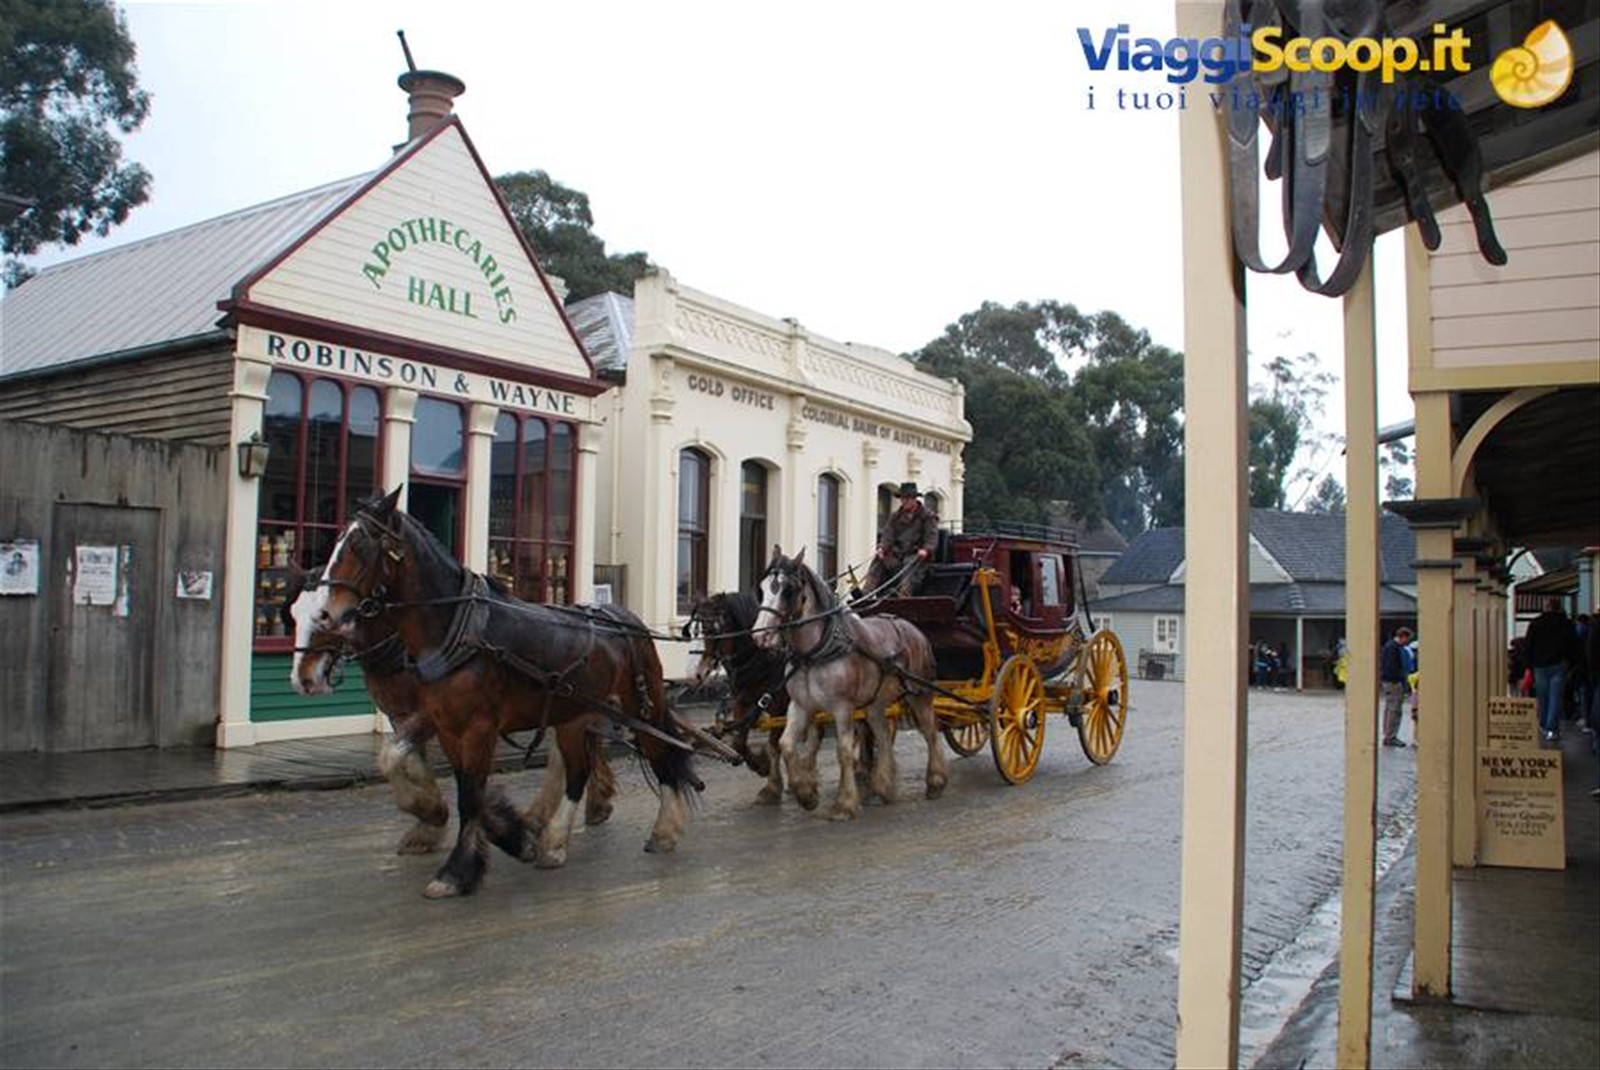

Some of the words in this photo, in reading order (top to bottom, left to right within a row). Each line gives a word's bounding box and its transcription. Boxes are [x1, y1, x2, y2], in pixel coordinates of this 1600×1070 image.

[362, 217, 517, 324] APOTHECARIES
[407, 276, 479, 319] HALL
[267, 334, 437, 388] ROBINSON
[454, 373, 470, 394] &
[490, 381, 576, 415] WAYNE
[688, 374, 724, 397] GOLD
[732, 386, 774, 411] OFFICE
[801, 405, 850, 430] COLONIAL
[852, 418, 878, 438] BANK
[1482, 756, 1514, 768] NEW
[1519, 757, 1558, 769] YORK
[1490, 767, 1549, 779] BAKERY
